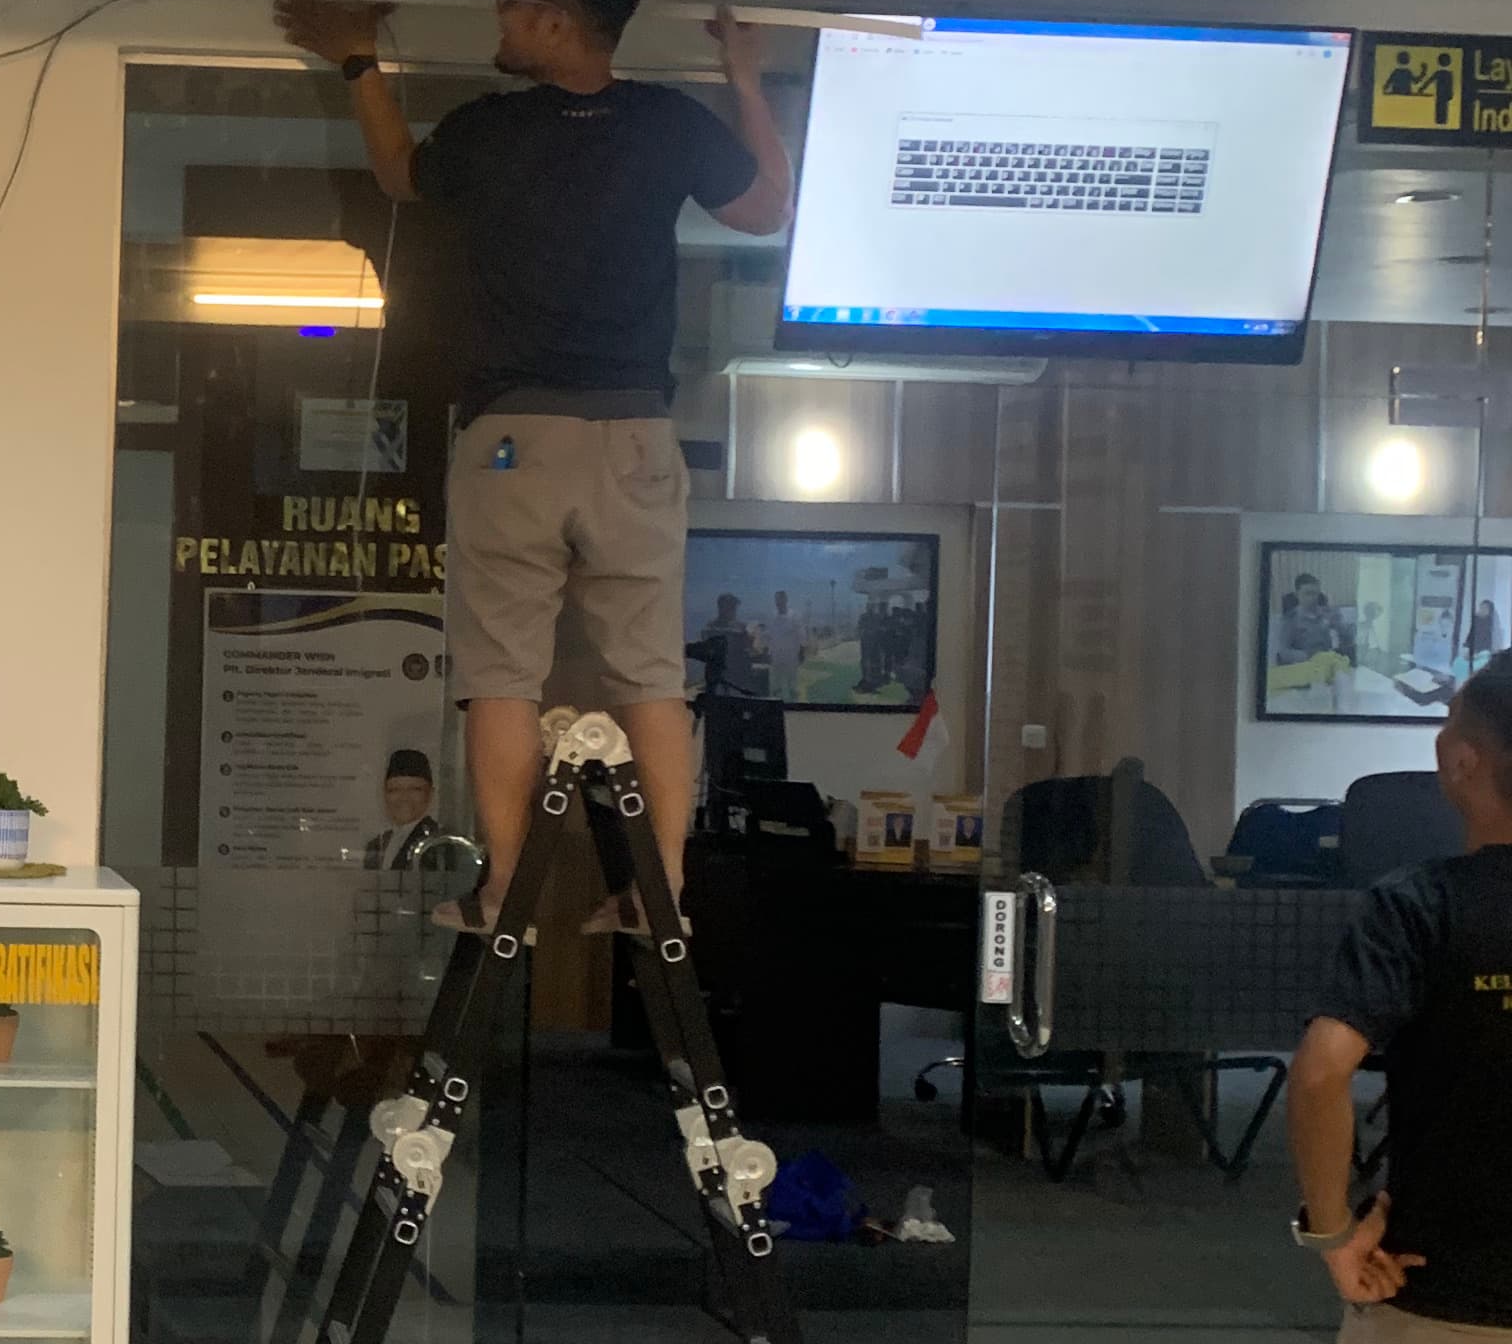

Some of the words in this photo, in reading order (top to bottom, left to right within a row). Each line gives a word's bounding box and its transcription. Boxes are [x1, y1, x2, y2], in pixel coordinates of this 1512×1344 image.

[283, 496, 420, 533] RUANG
[175, 537, 376, 576] PELAYANAN
[993, 899, 1007, 968] DORONG
